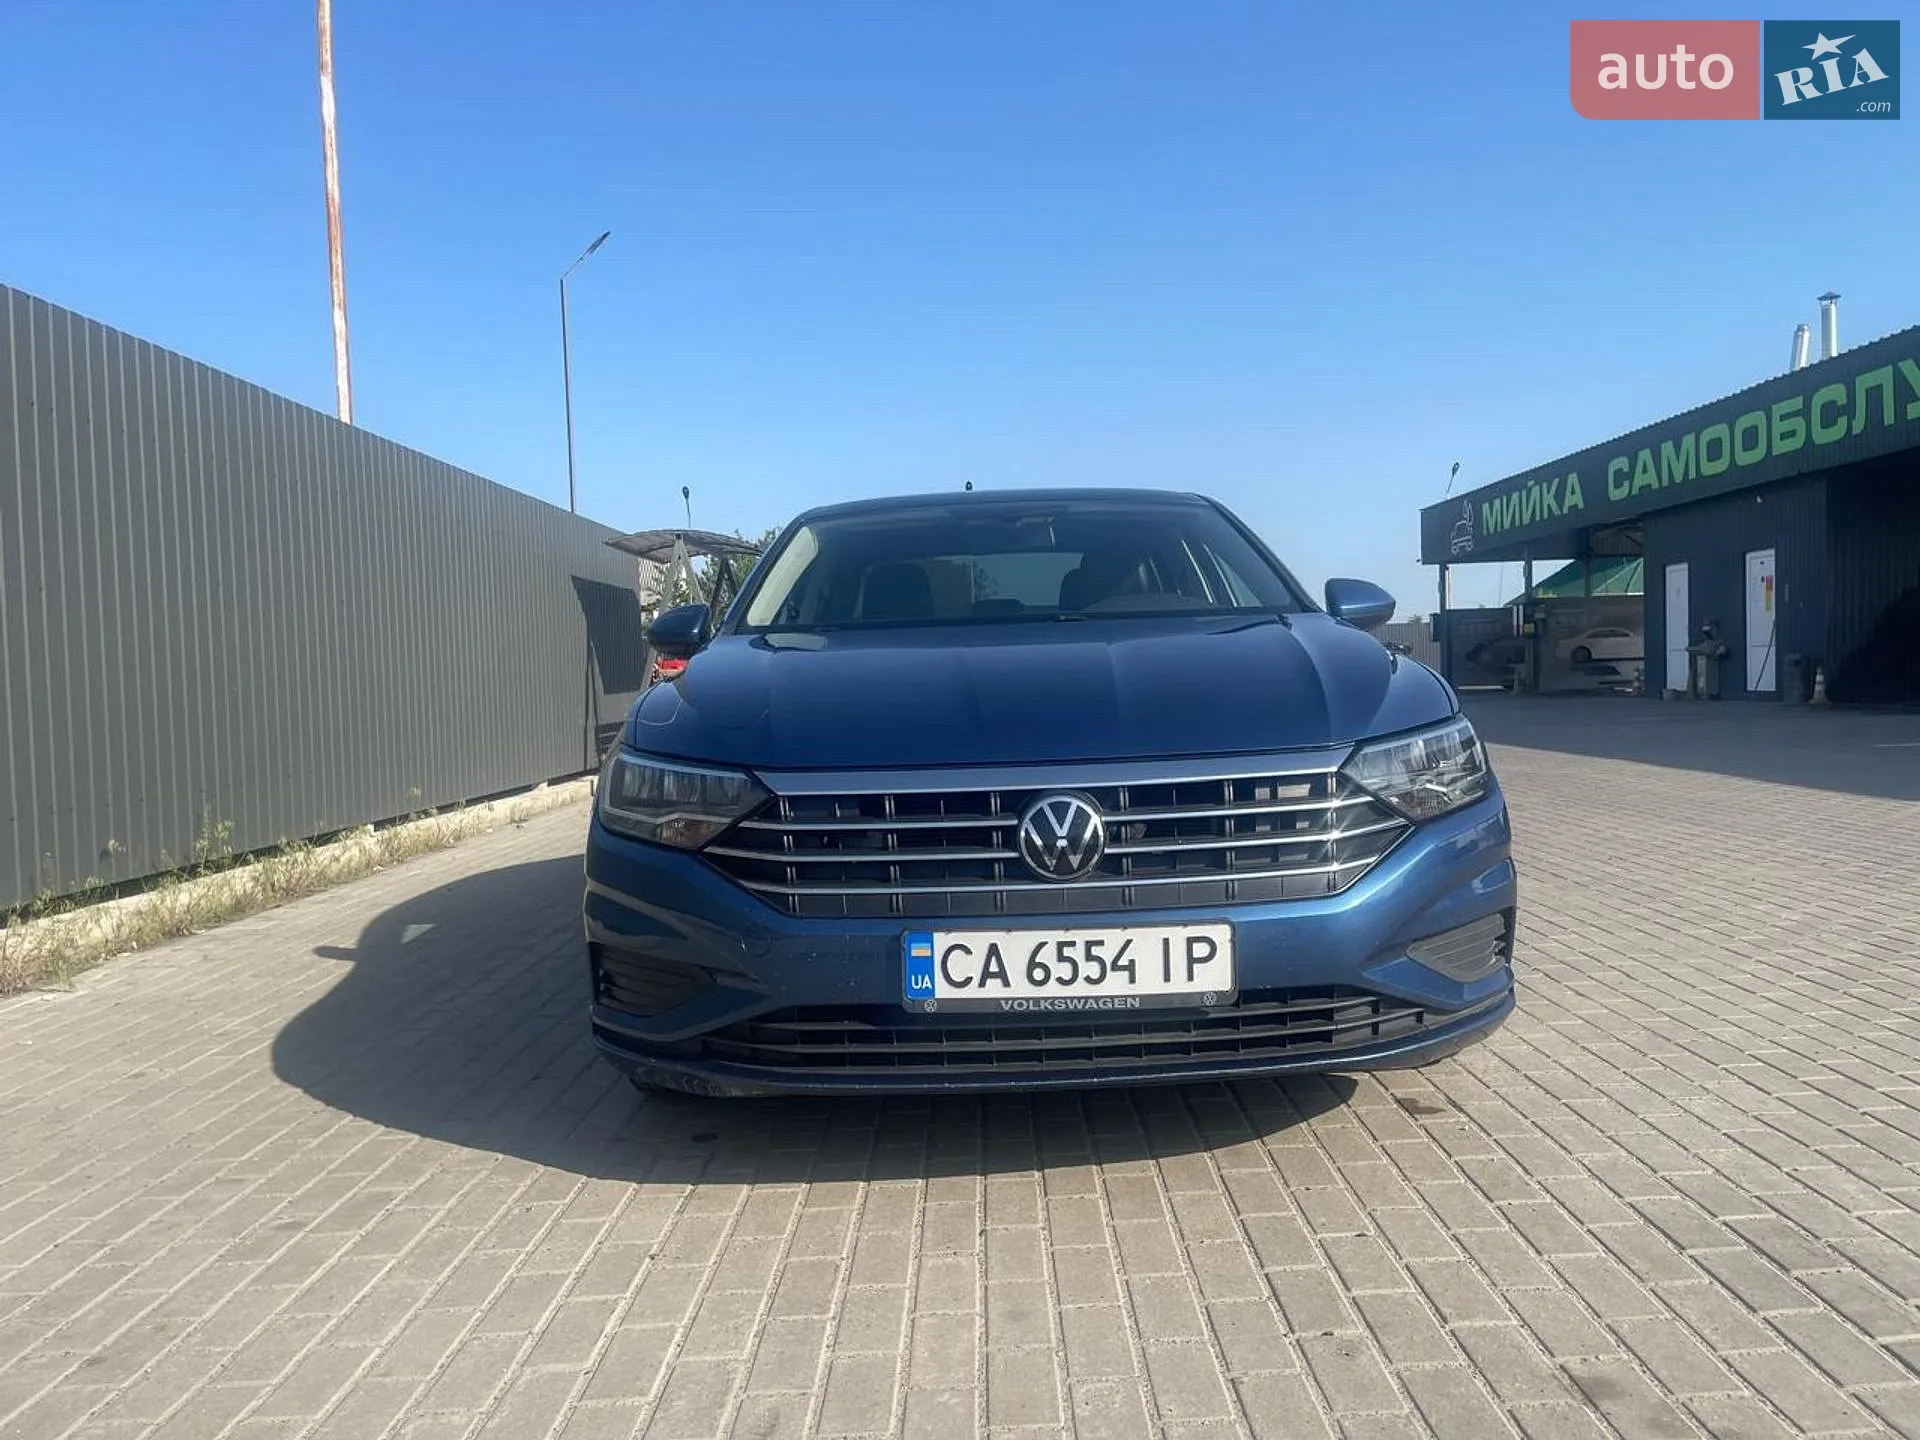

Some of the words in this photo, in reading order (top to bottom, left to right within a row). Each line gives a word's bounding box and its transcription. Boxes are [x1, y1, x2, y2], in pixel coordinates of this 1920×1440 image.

[1481, 472, 1585, 536] МИЙКА
[940, 942, 1011, 989] CA
[1026, 938, 1137, 987] 6554
[1162, 935, 1218, 983] IP
[911, 975, 933, 990] UA
[1001, 997, 1140, 1012] VOLKSWAGEN
